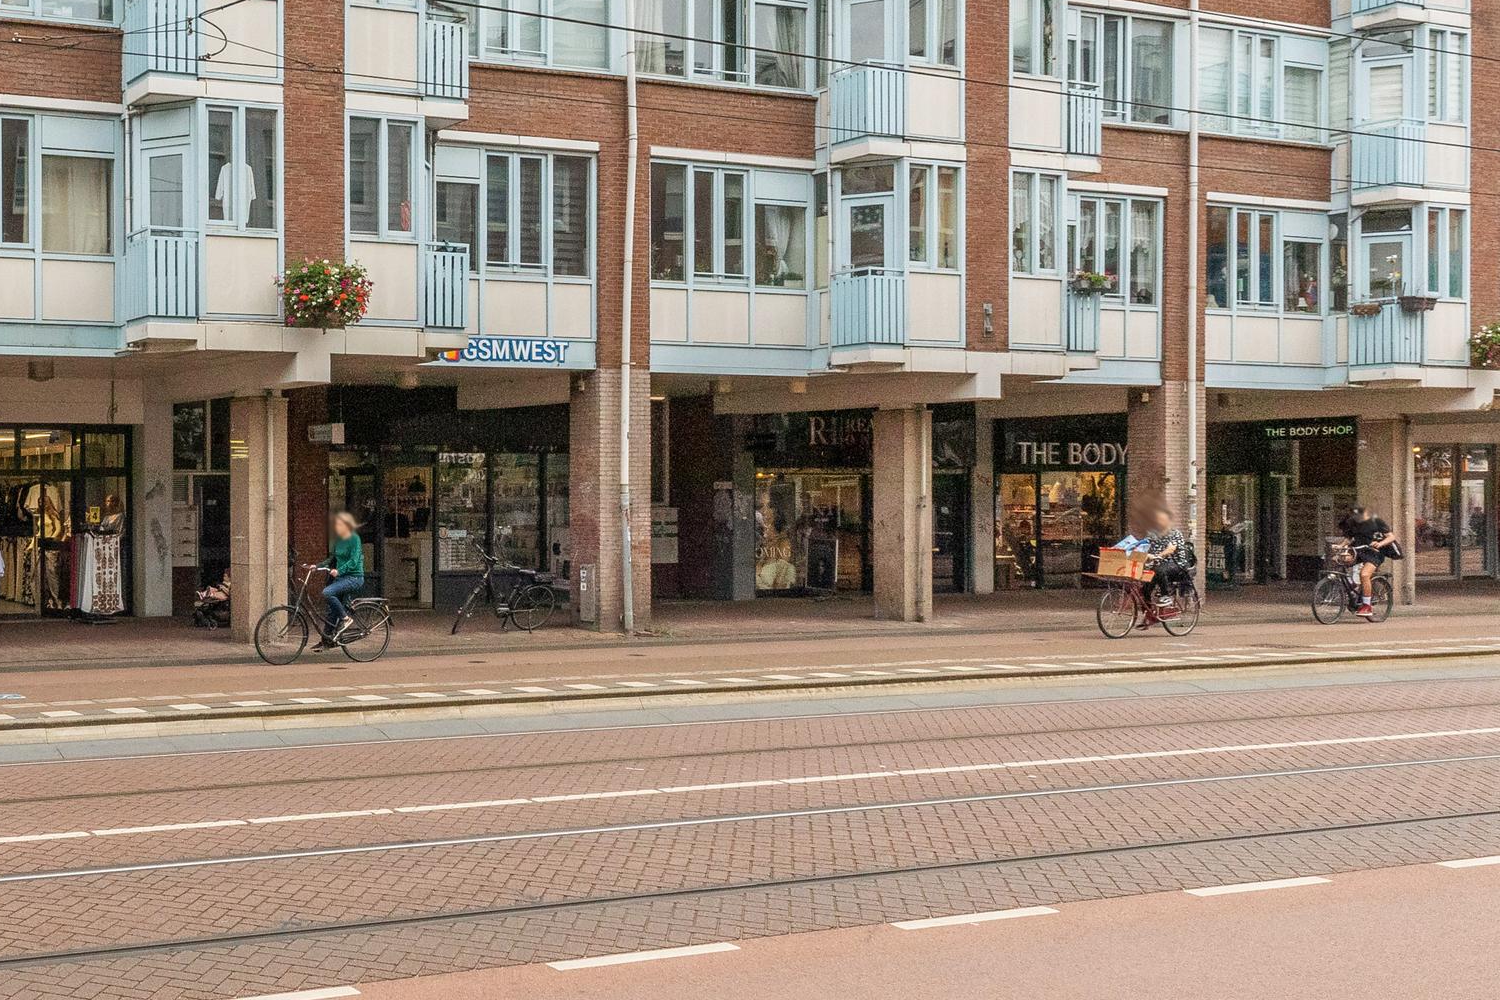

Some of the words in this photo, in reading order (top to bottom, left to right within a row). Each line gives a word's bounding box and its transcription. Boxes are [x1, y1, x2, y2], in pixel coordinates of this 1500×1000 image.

[1265, 428, 1286, 436] THE
[1290, 427, 1320, 436] BODY
[1017, 441, 1060, 465] THE
[1068, 442, 1128, 465] BODY
